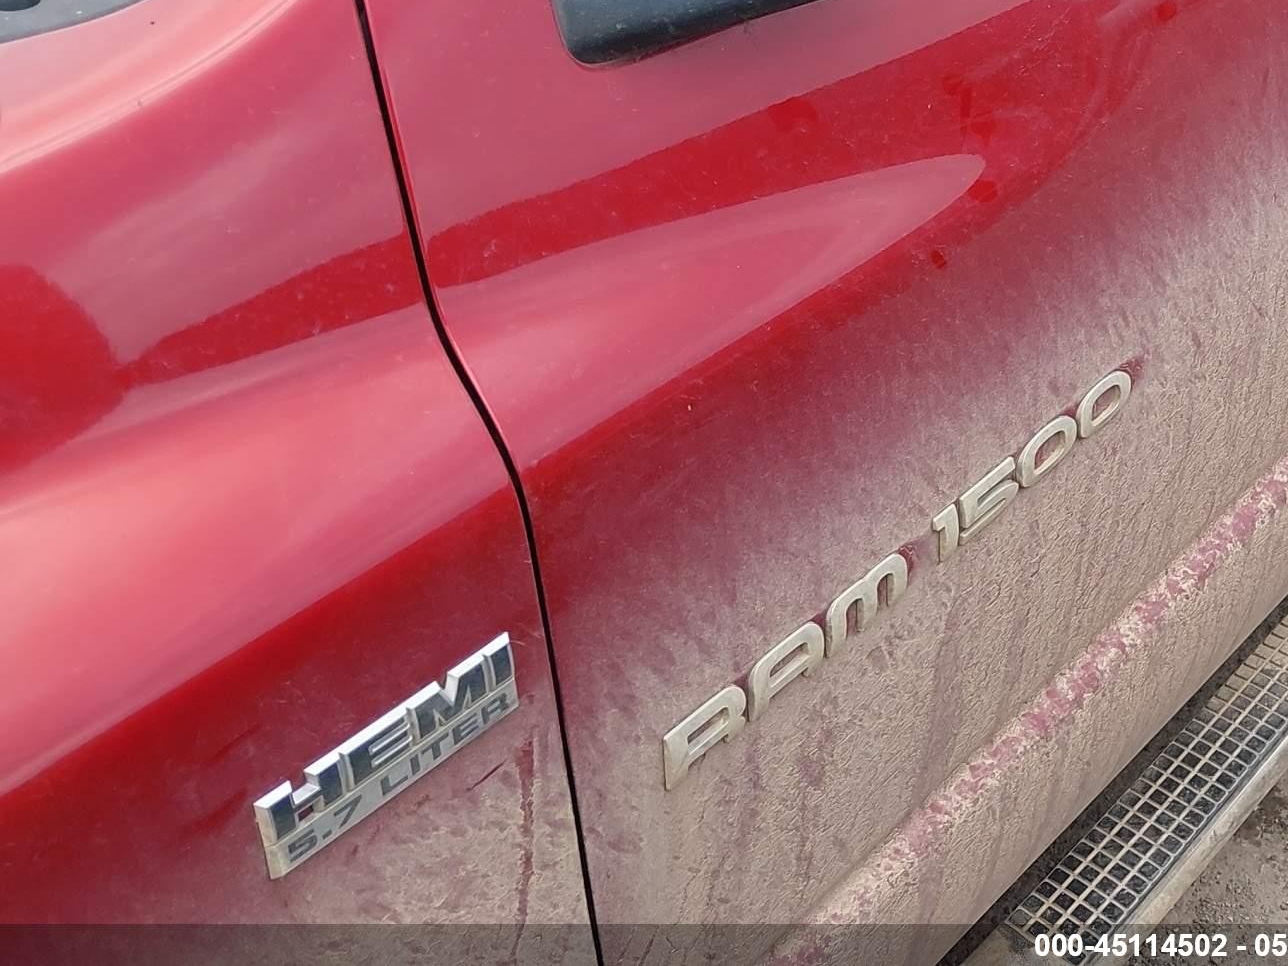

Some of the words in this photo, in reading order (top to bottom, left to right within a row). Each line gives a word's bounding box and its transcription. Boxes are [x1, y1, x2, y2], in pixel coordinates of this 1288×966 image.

[662, 551, 910, 792] RAM
[931, 370, 1132, 565] 1500
[253, 631, 516, 845] HEMI
[287, 794, 362, 864] 5.7
[381, 692, 510, 797] LITER
